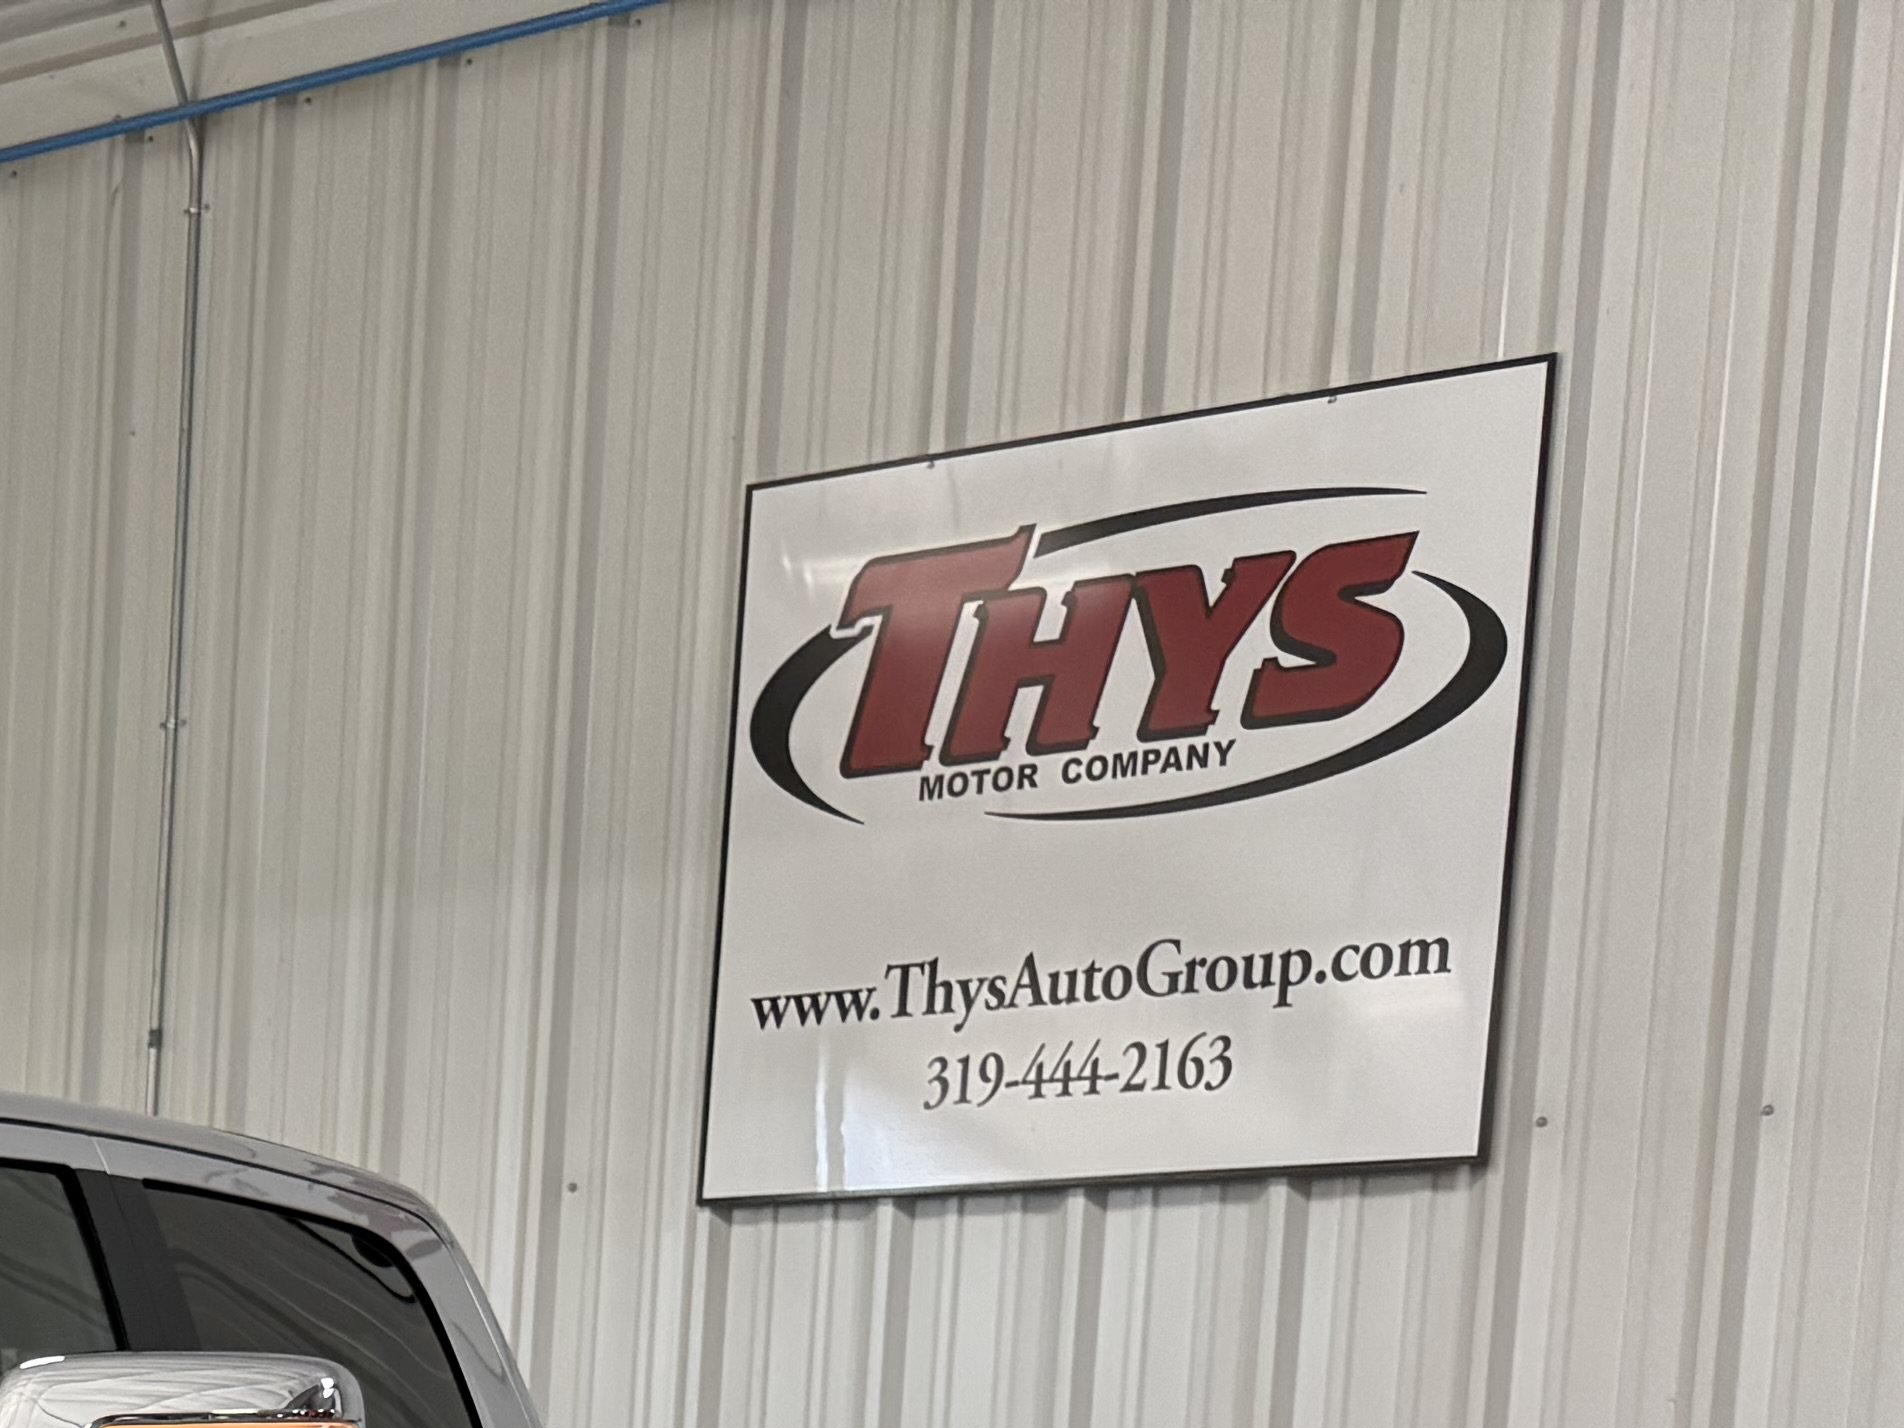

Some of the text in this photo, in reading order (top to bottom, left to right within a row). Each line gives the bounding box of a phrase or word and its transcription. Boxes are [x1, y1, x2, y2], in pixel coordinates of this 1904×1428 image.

[838, 524, 1421, 780] THYS
[917, 739, 1237, 803] MOTOR COMPANY
[750, 936, 1452, 1032] www.ThysAutoGroup.com
[922, 1031, 1235, 1110] 319-444-2163
